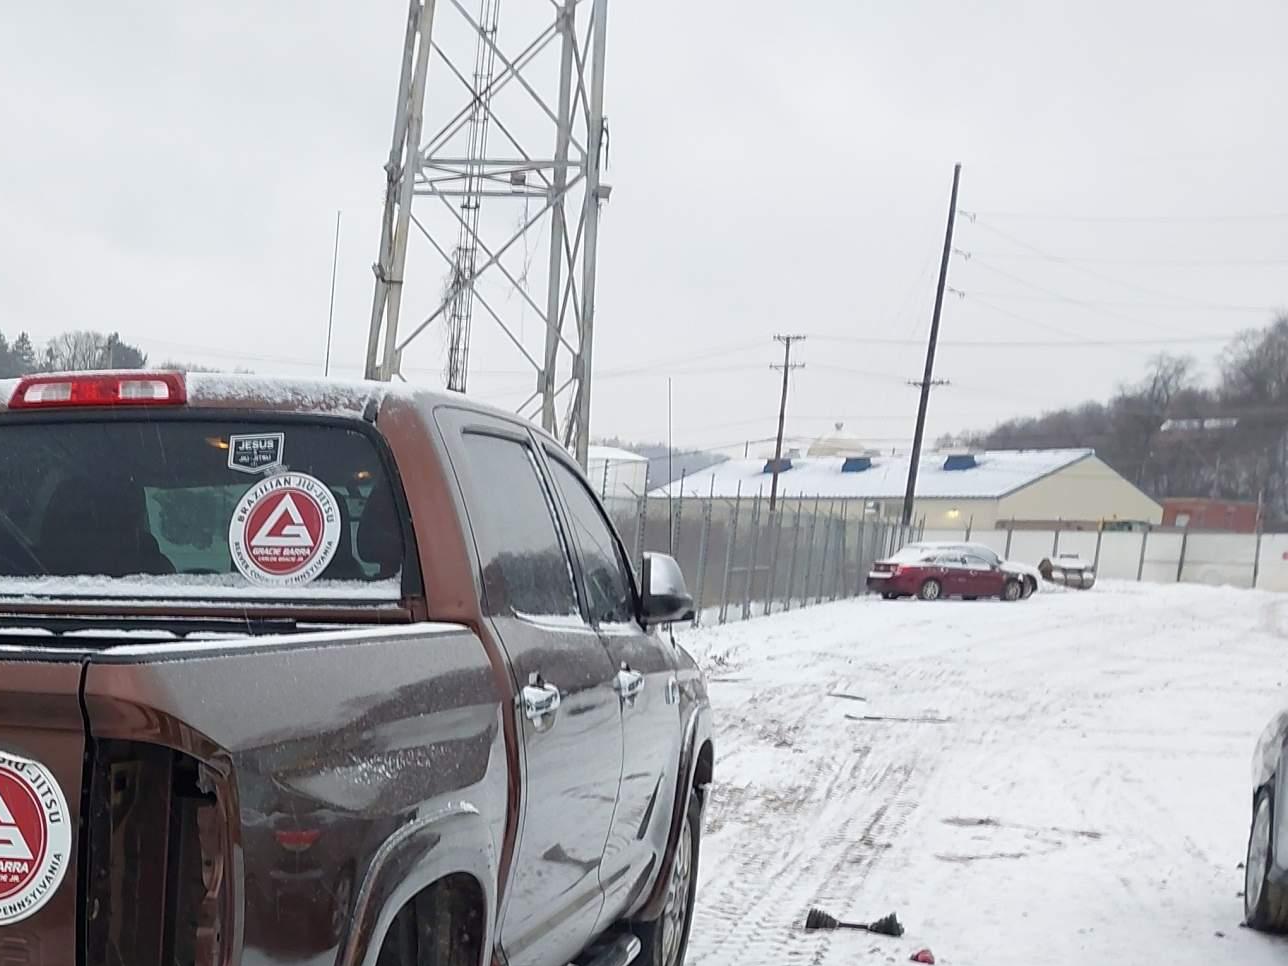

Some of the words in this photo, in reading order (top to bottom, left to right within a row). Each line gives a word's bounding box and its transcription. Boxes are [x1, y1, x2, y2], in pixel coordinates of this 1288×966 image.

[238, 439, 274, 450] JESUS
[238, 477, 292, 523] BRAZILIAN
[297, 478, 335, 523] JIU-JITSU
